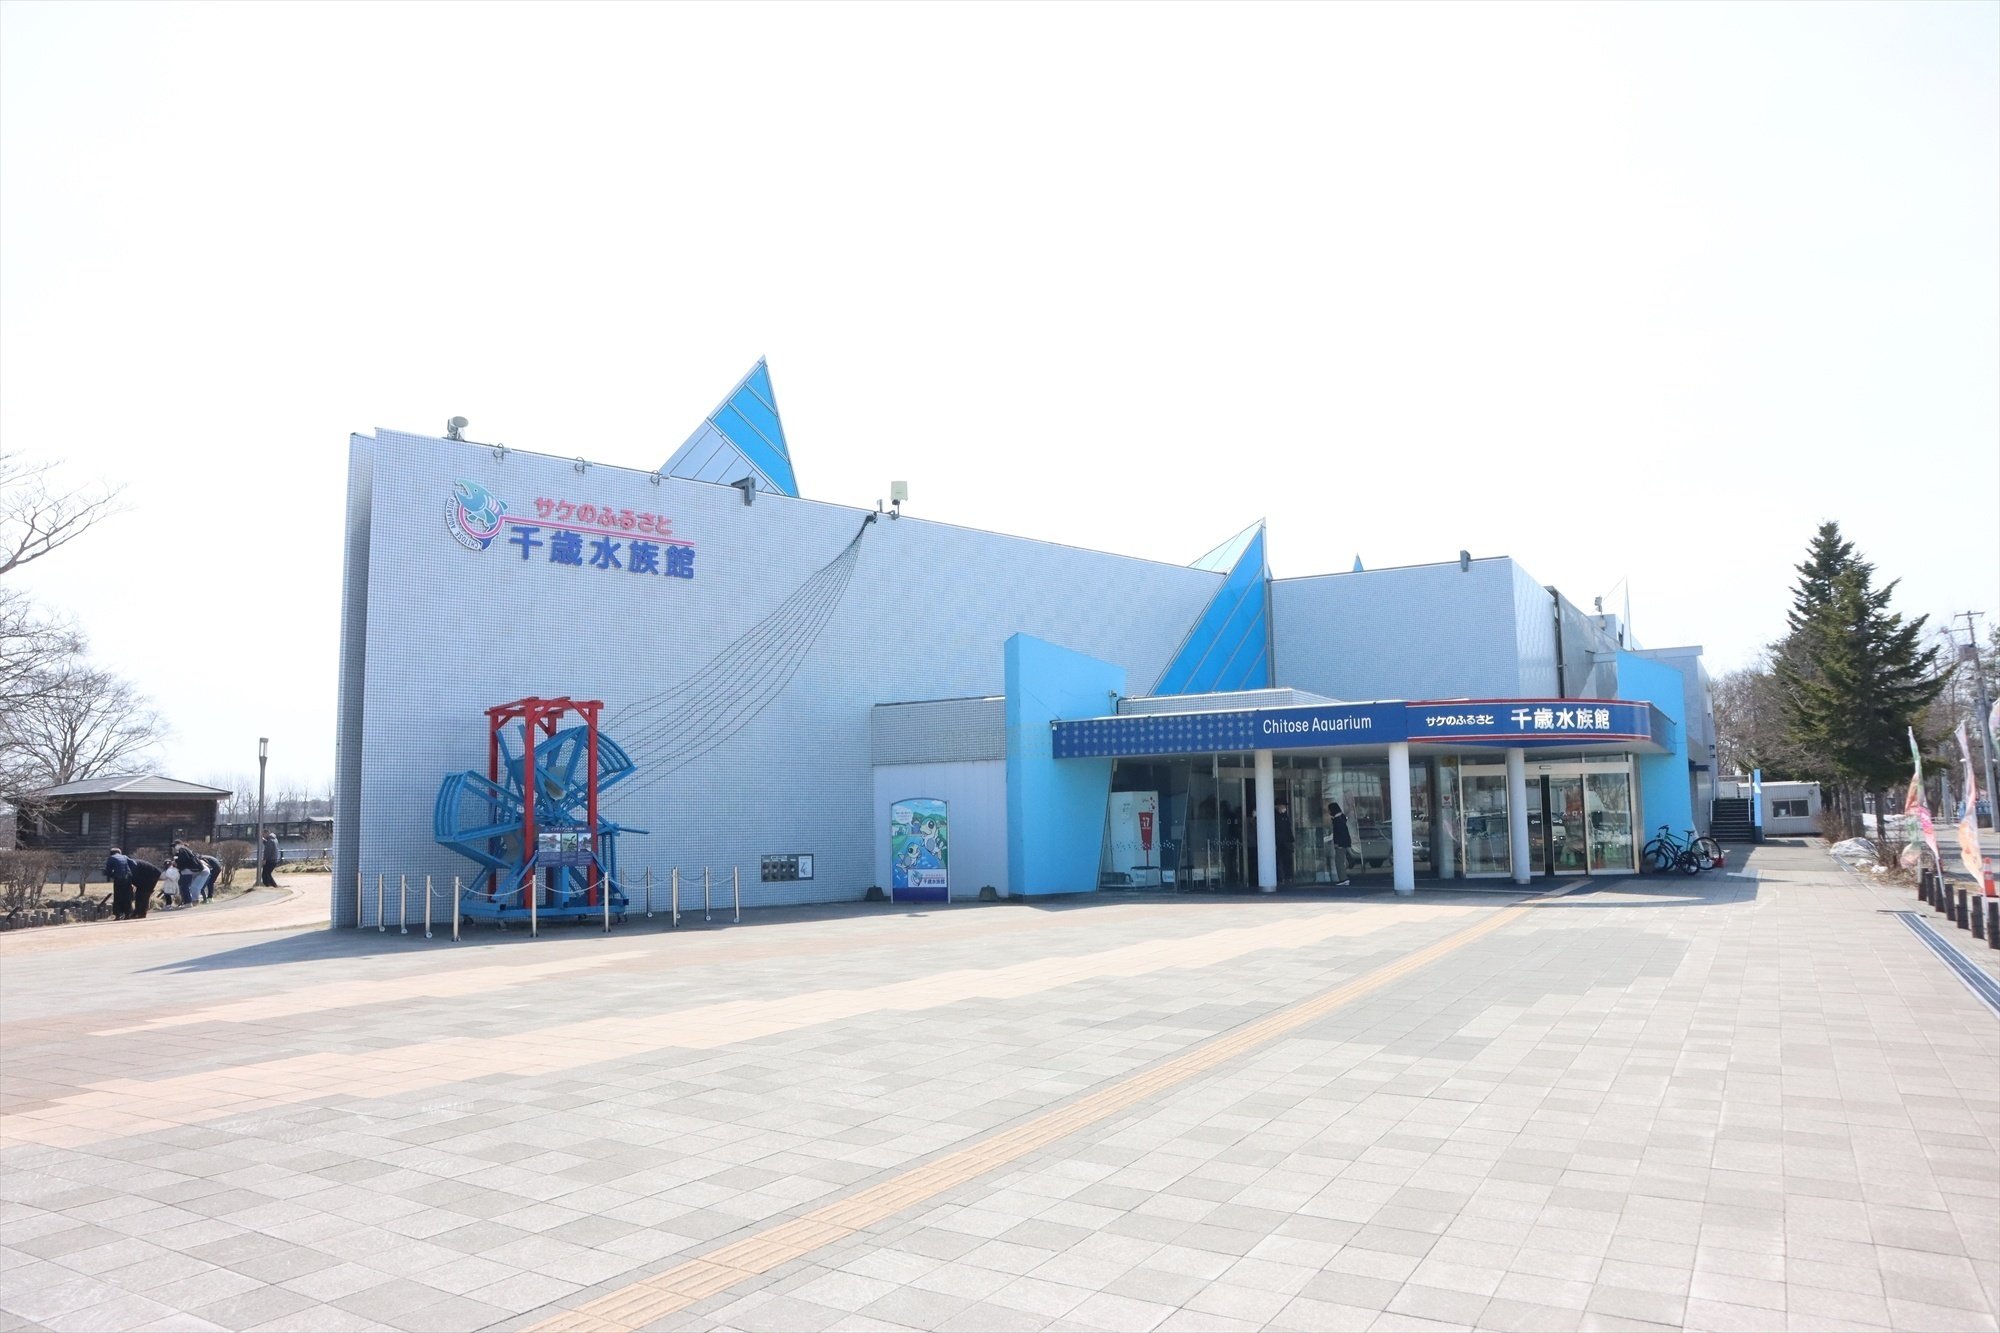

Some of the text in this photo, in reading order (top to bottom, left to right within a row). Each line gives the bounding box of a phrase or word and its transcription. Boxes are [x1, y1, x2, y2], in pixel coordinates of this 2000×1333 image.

[535, 496, 673, 535] サケのふるさと
[455, 531, 479, 549] CHITOSE
[509, 526, 695, 579] 千歳水族館
[1263, 715, 1372, 734] Chitose Aquarium
[1425, 714, 1494, 727] サケのふるさと
[1510, 707, 1610, 730] 千歳水族館
